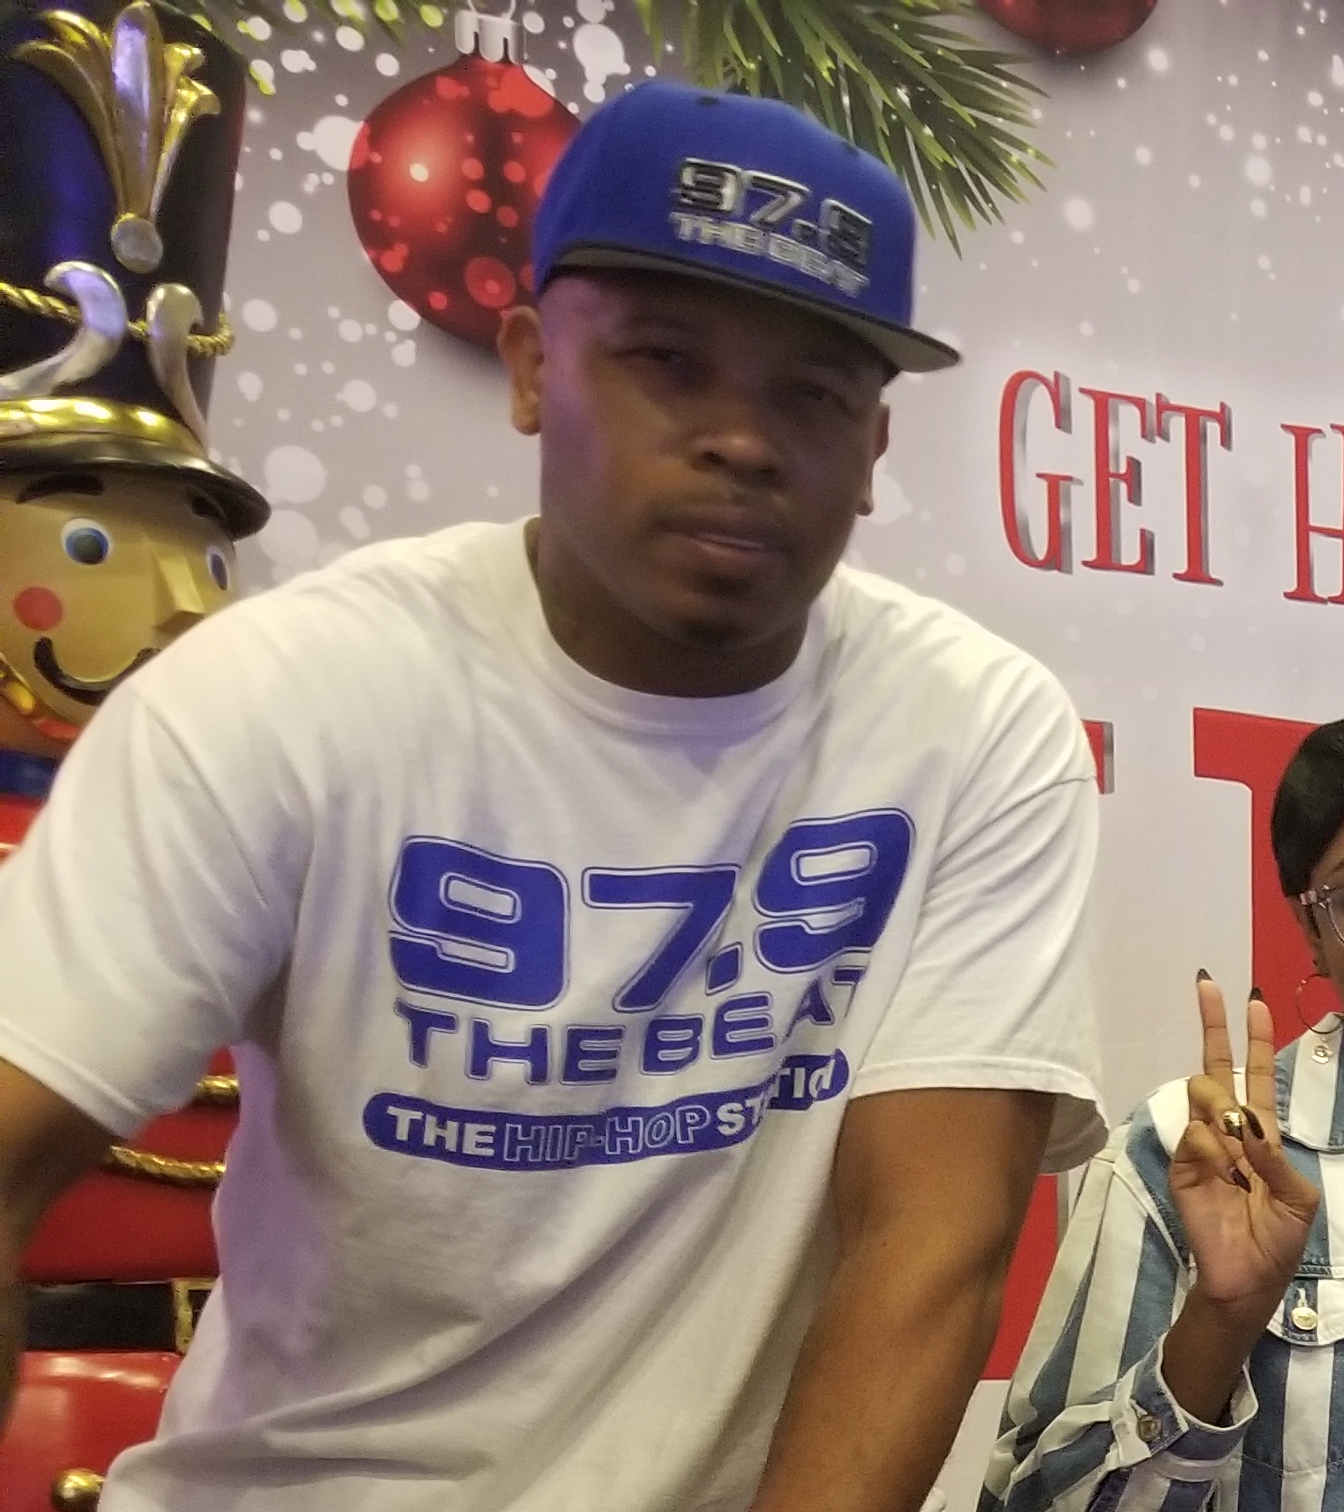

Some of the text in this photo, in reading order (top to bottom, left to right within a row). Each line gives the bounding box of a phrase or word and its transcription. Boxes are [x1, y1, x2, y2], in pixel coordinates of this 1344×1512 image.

[998, 369, 1232, 587] GET
[388, 807, 916, 1012] 97.9
[394, 997, 627, 1086] THE
[386, 1105, 498, 1156] THE
[502, 1104, 712, 1163] HIP-HOP
